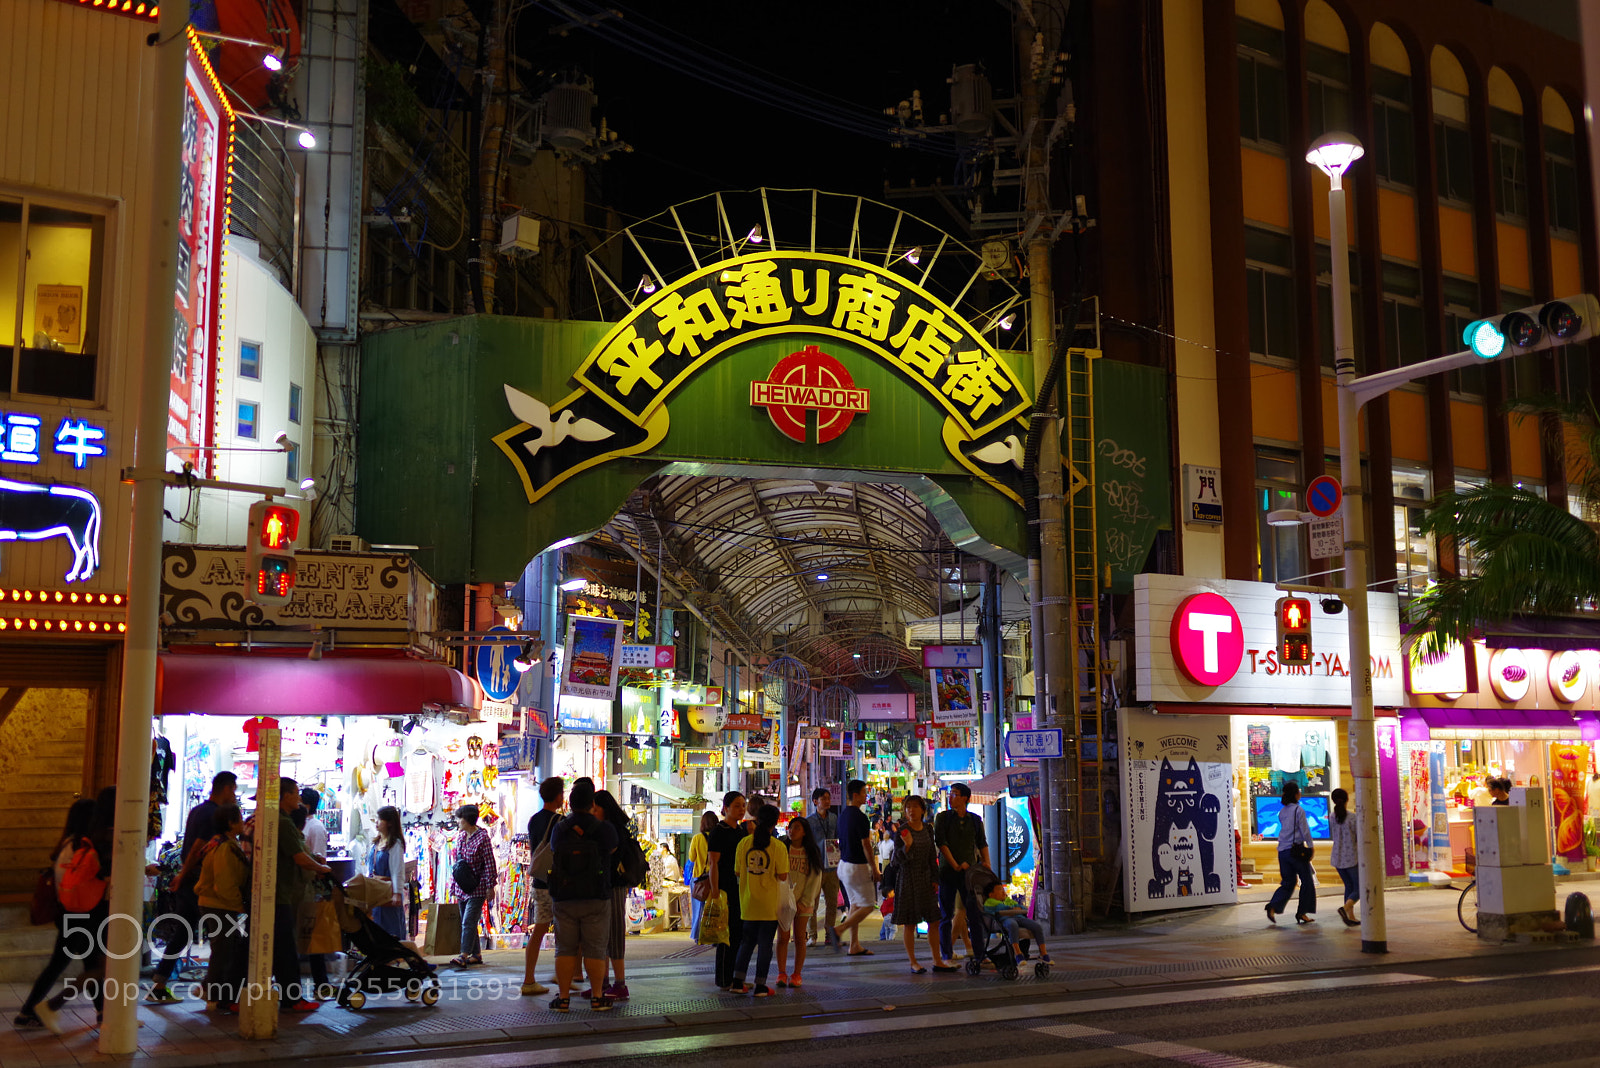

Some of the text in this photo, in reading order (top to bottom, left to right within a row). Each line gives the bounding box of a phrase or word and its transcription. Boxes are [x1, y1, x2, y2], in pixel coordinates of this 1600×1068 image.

[597, 259, 1012, 421] 平和通り商店街
[757, 384, 865, 409] HEIWADORI
[1197, 475, 1217, 499] 門
[200, 556, 374, 590] AENT
[1188, 612, 1233, 674] T
[1247, 649, 1393, 678] T-S-YA.M
[660, 710, 670, 727] A2
[1016, 733, 1053, 747] 平和通り
[1160, 738, 1198, 749] WELCOME
